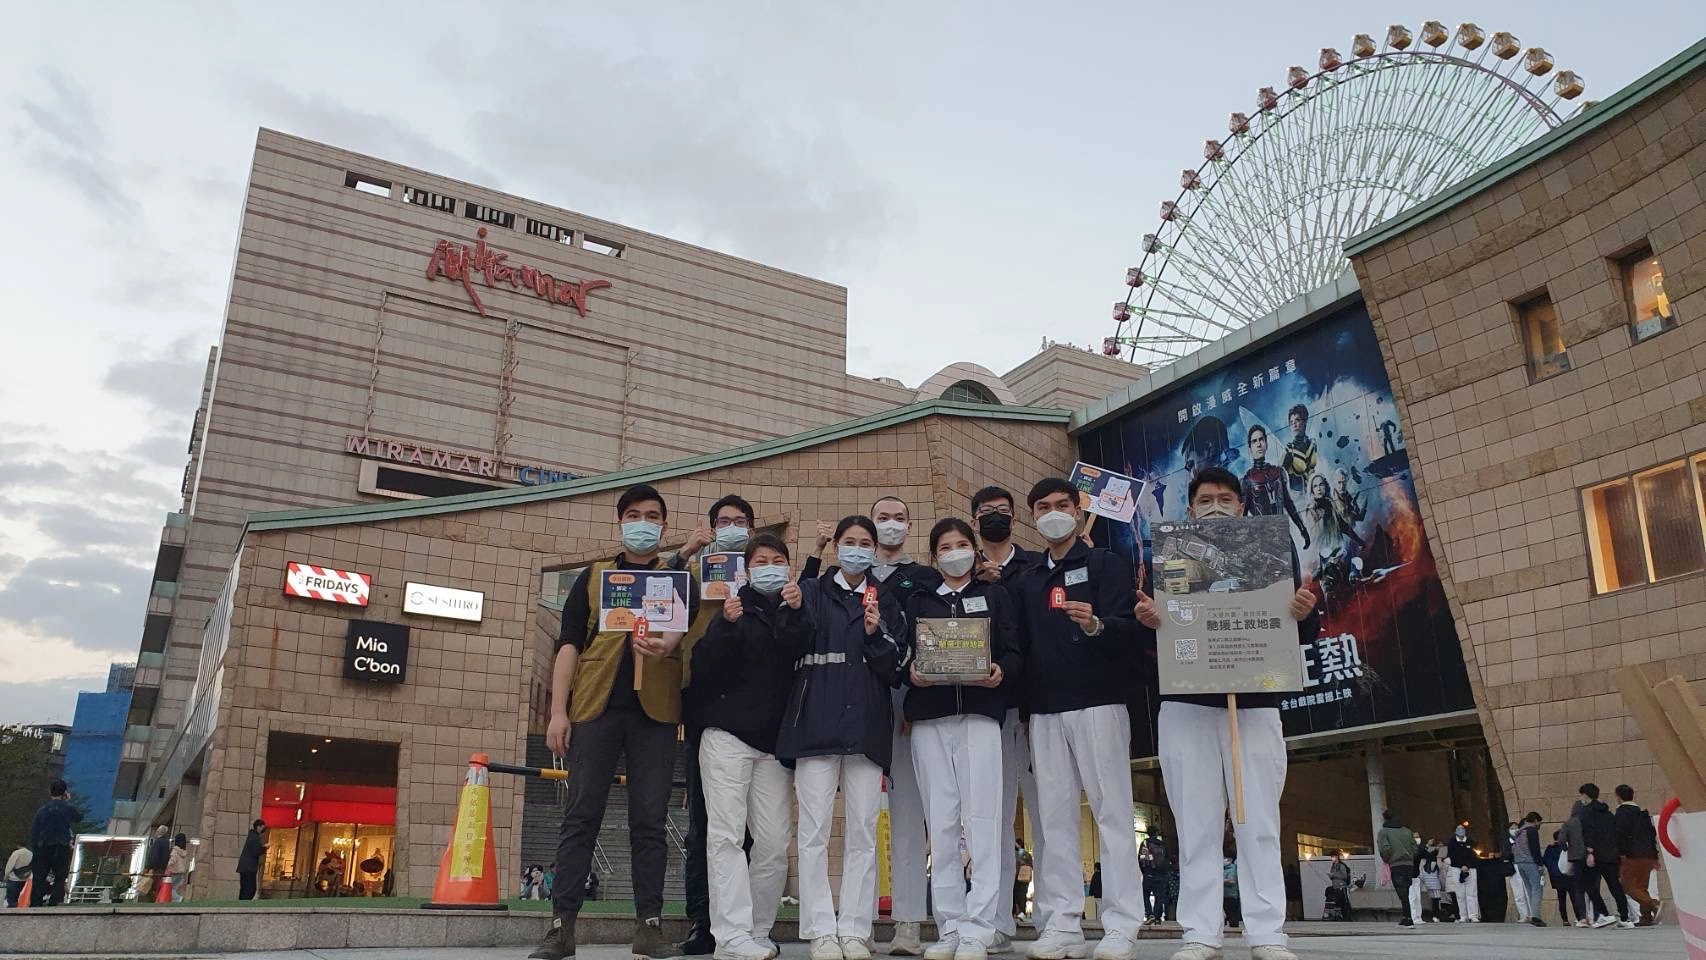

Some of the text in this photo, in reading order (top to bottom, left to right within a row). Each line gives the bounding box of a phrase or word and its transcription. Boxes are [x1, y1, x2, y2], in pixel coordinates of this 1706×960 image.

[347, 436, 497, 477] MIRAMAR
[305, 576, 359, 594] FRIDAYS
[611, 597, 632, 607] LINE
[356, 636, 388, 653] Mia
[353, 656, 400, 675] C'bon
